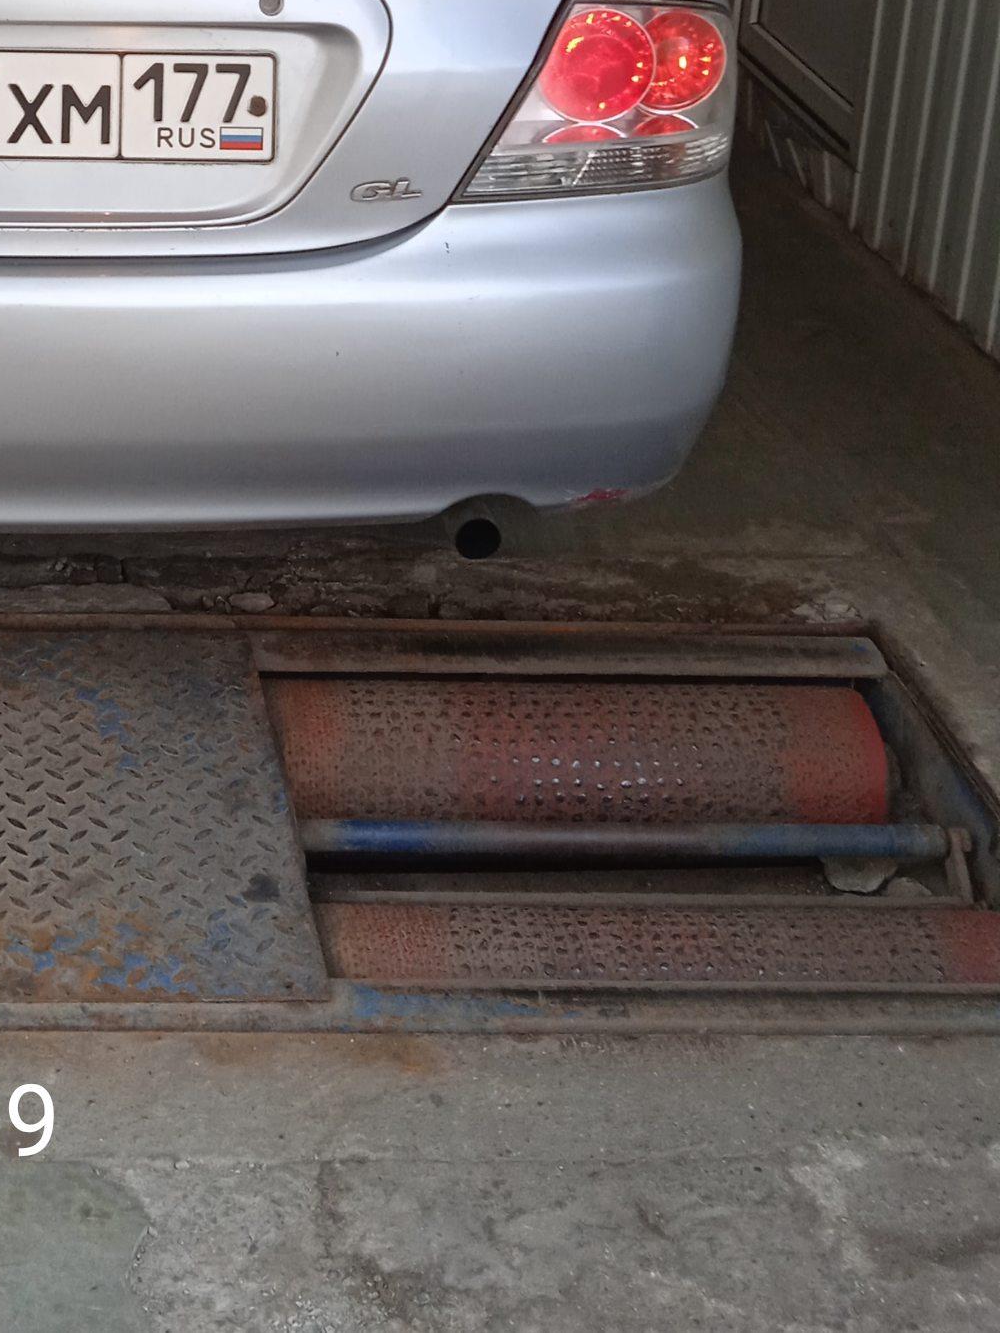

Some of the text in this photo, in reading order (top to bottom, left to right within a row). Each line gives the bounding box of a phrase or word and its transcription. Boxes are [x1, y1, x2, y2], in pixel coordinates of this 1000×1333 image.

[133, 62, 252, 123] 177
[157, 127, 216, 149] RUS
[350, 177, 422, 202] GL
